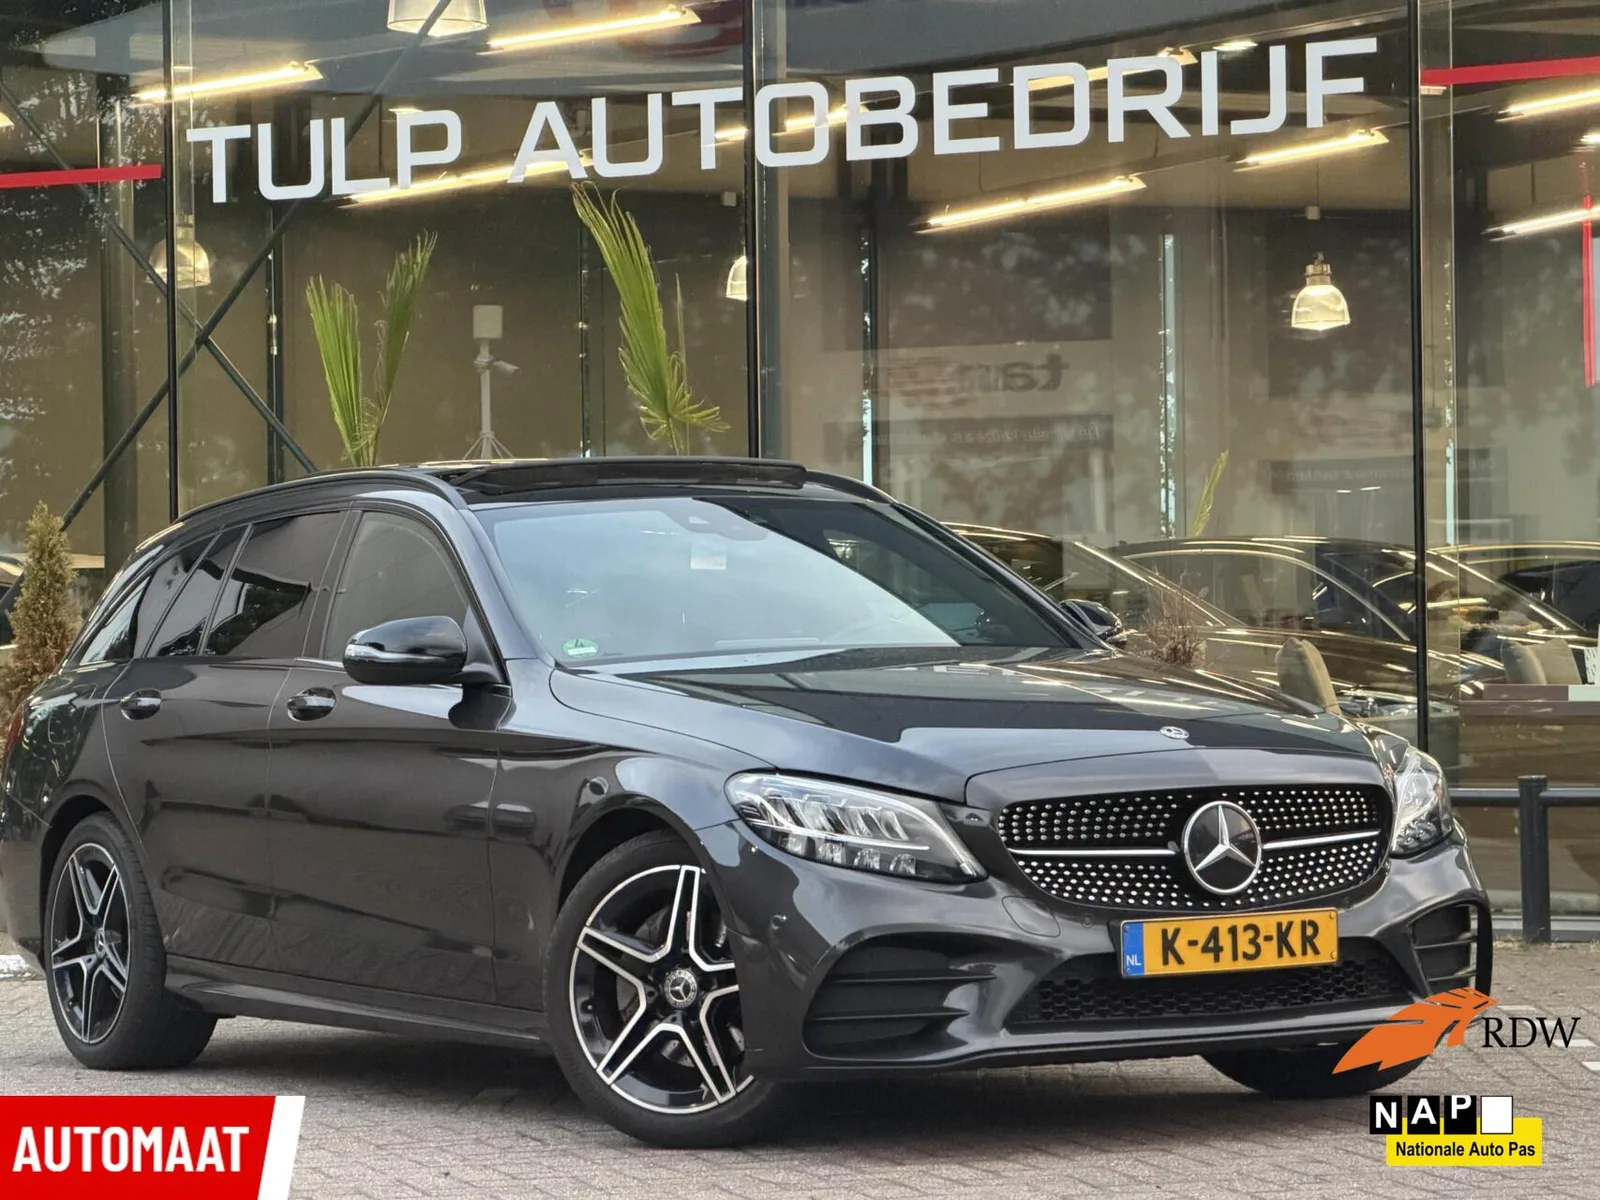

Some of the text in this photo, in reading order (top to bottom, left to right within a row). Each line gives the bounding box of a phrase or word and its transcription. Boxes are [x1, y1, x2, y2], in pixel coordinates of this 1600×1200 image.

[187, 37, 1378, 204] TULP AUTOBEDRIJF
[1126, 954, 1142, 967] NL
[1161, 919, 1321, 966] K-413-KR
